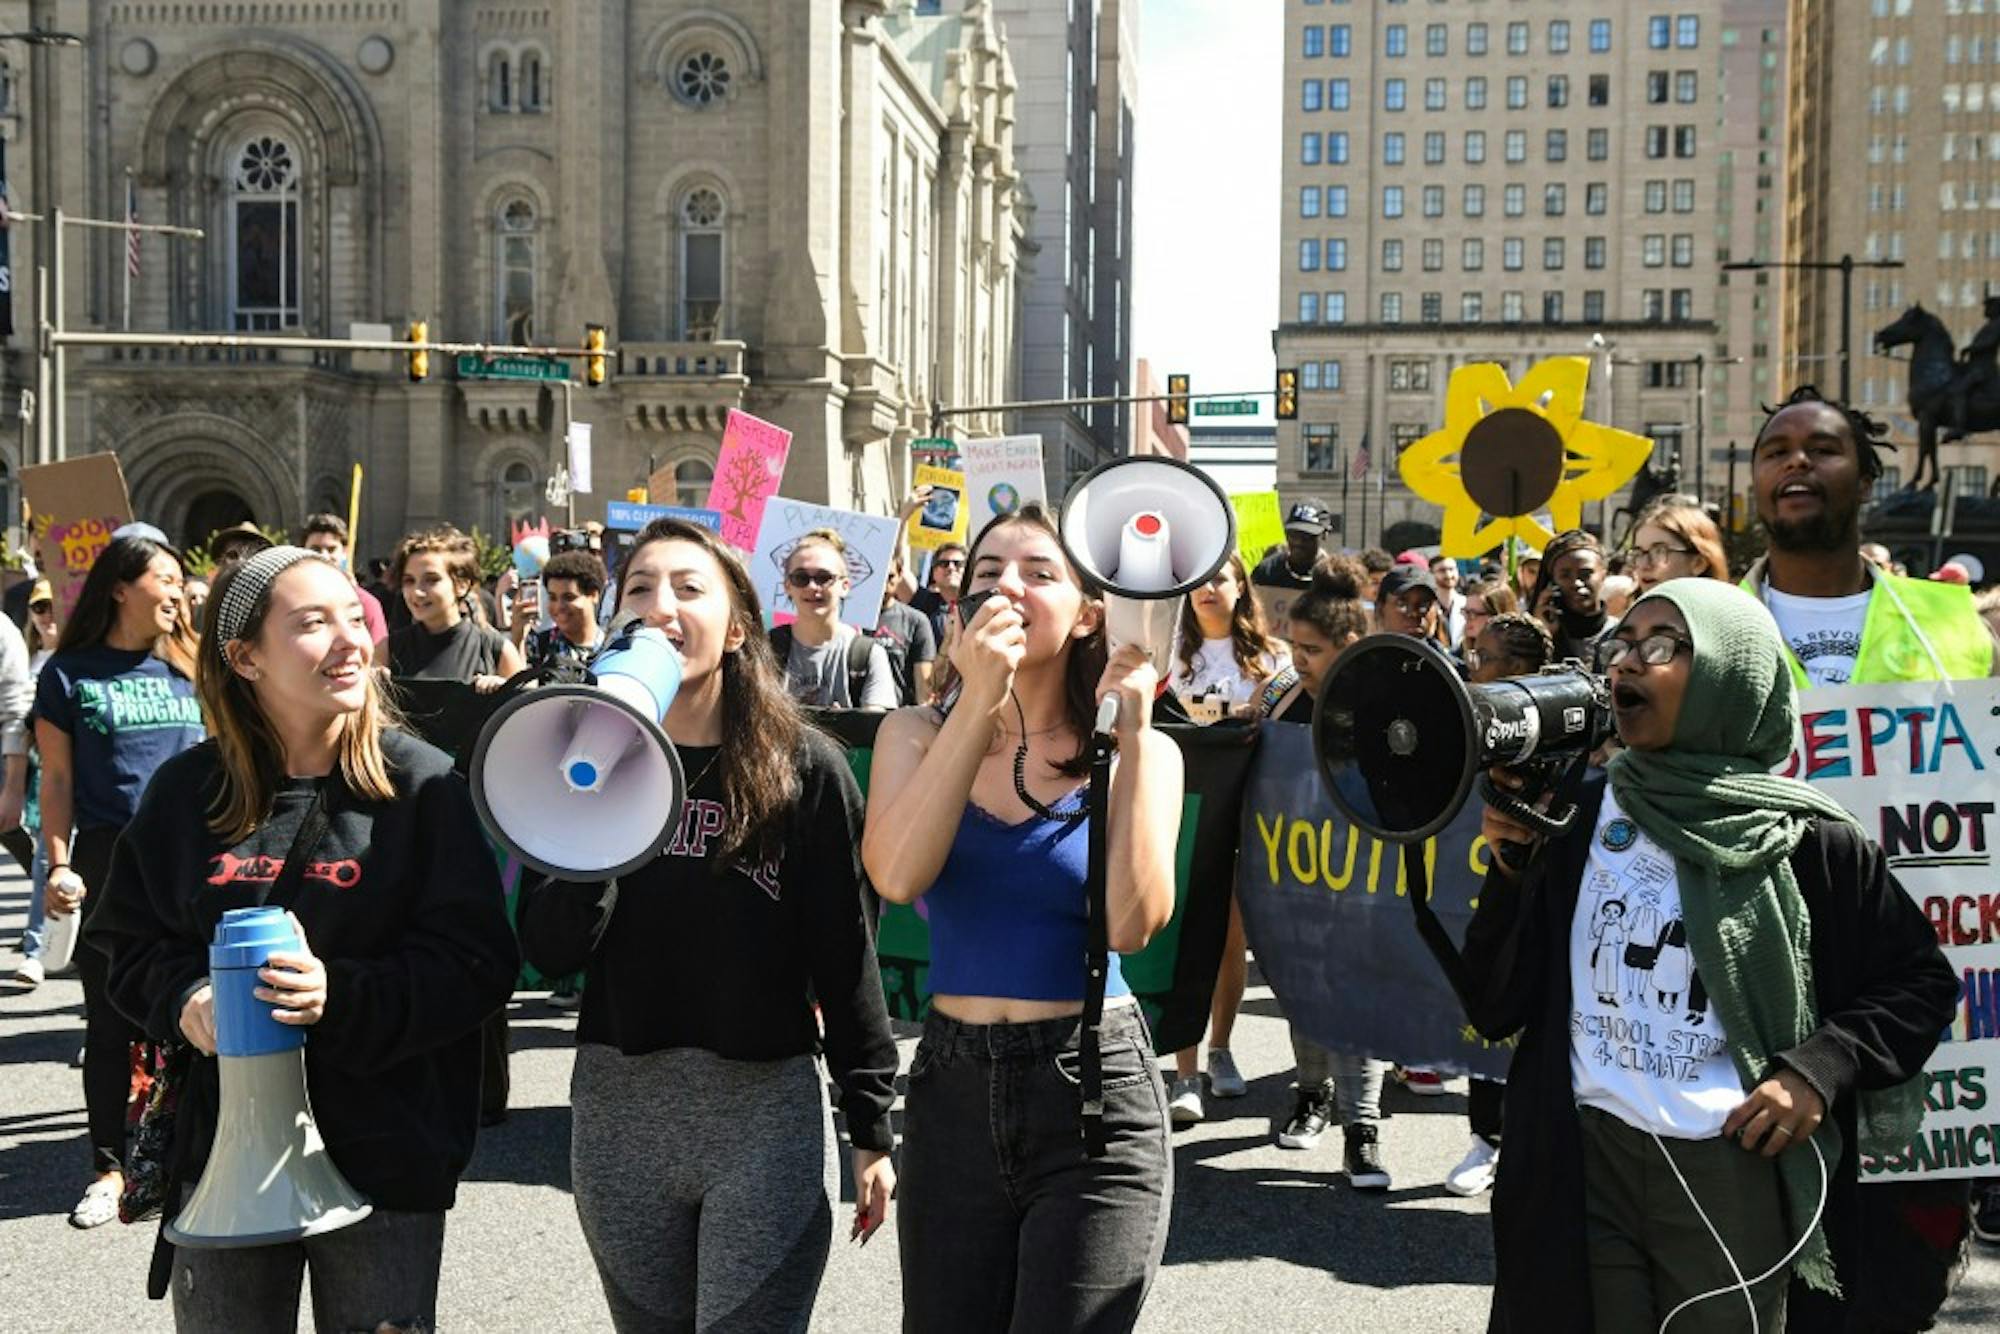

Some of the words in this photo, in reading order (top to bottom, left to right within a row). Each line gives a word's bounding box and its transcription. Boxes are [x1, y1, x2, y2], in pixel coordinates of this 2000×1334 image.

[783, 504, 881, 541] PLANET
[107, 677, 174, 704] GREEN
[1778, 702, 1985, 781] EPTA
[1880, 800, 1995, 857] NOT
[1570, 1011, 1655, 1048] SCHOOL
[1593, 1040, 1613, 1067] 4
